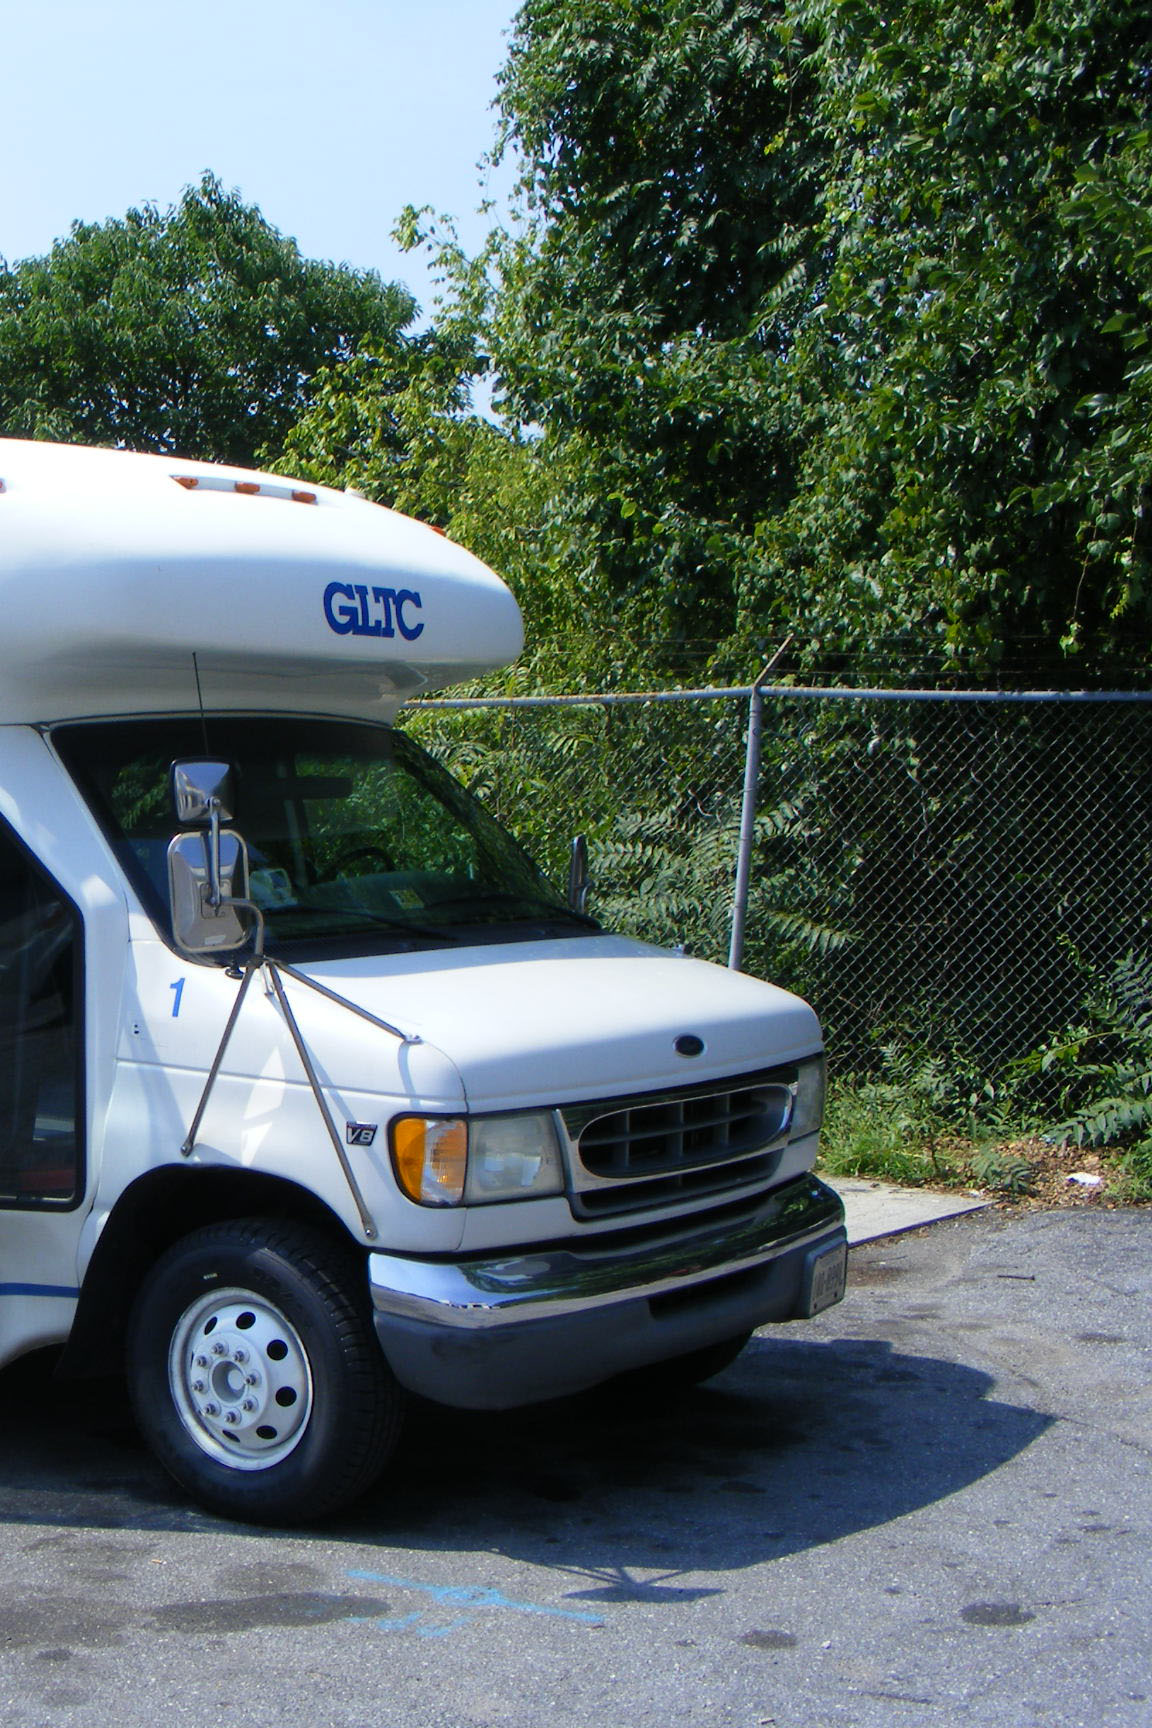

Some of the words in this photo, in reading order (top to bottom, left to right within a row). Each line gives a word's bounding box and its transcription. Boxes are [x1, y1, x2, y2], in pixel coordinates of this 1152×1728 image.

[323, 582, 424, 641] GLTC
[169, 977, 185, 1018] 1
[347, 1127, 375, 1143] V8
